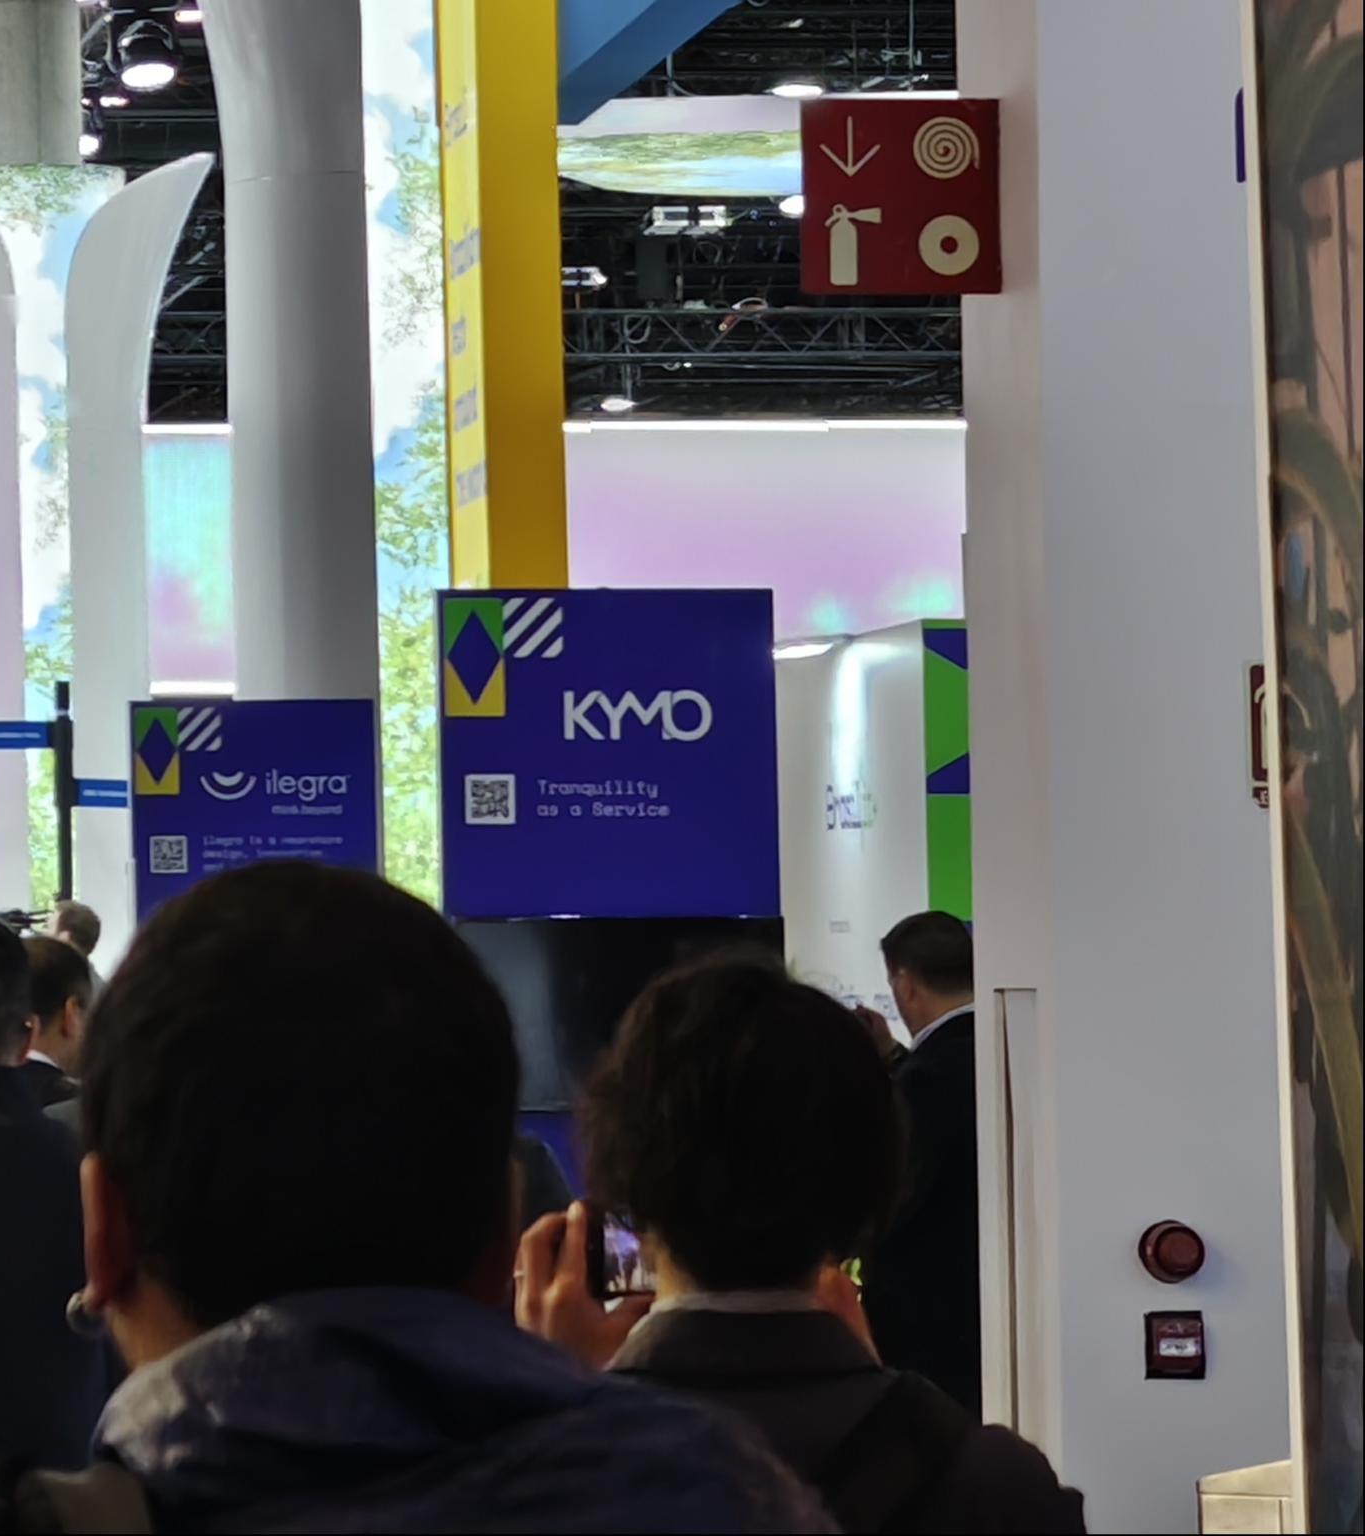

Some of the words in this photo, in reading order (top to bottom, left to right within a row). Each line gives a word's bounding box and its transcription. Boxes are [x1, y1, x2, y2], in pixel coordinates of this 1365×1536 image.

[563, 689, 713, 741] KYMO
[265, 768, 348, 801] ilegra
[537, 780, 658, 798] Tranquility
[536, 804, 559, 816] as
[569, 805, 582, 816] a
[591, 802, 671, 816] Service
